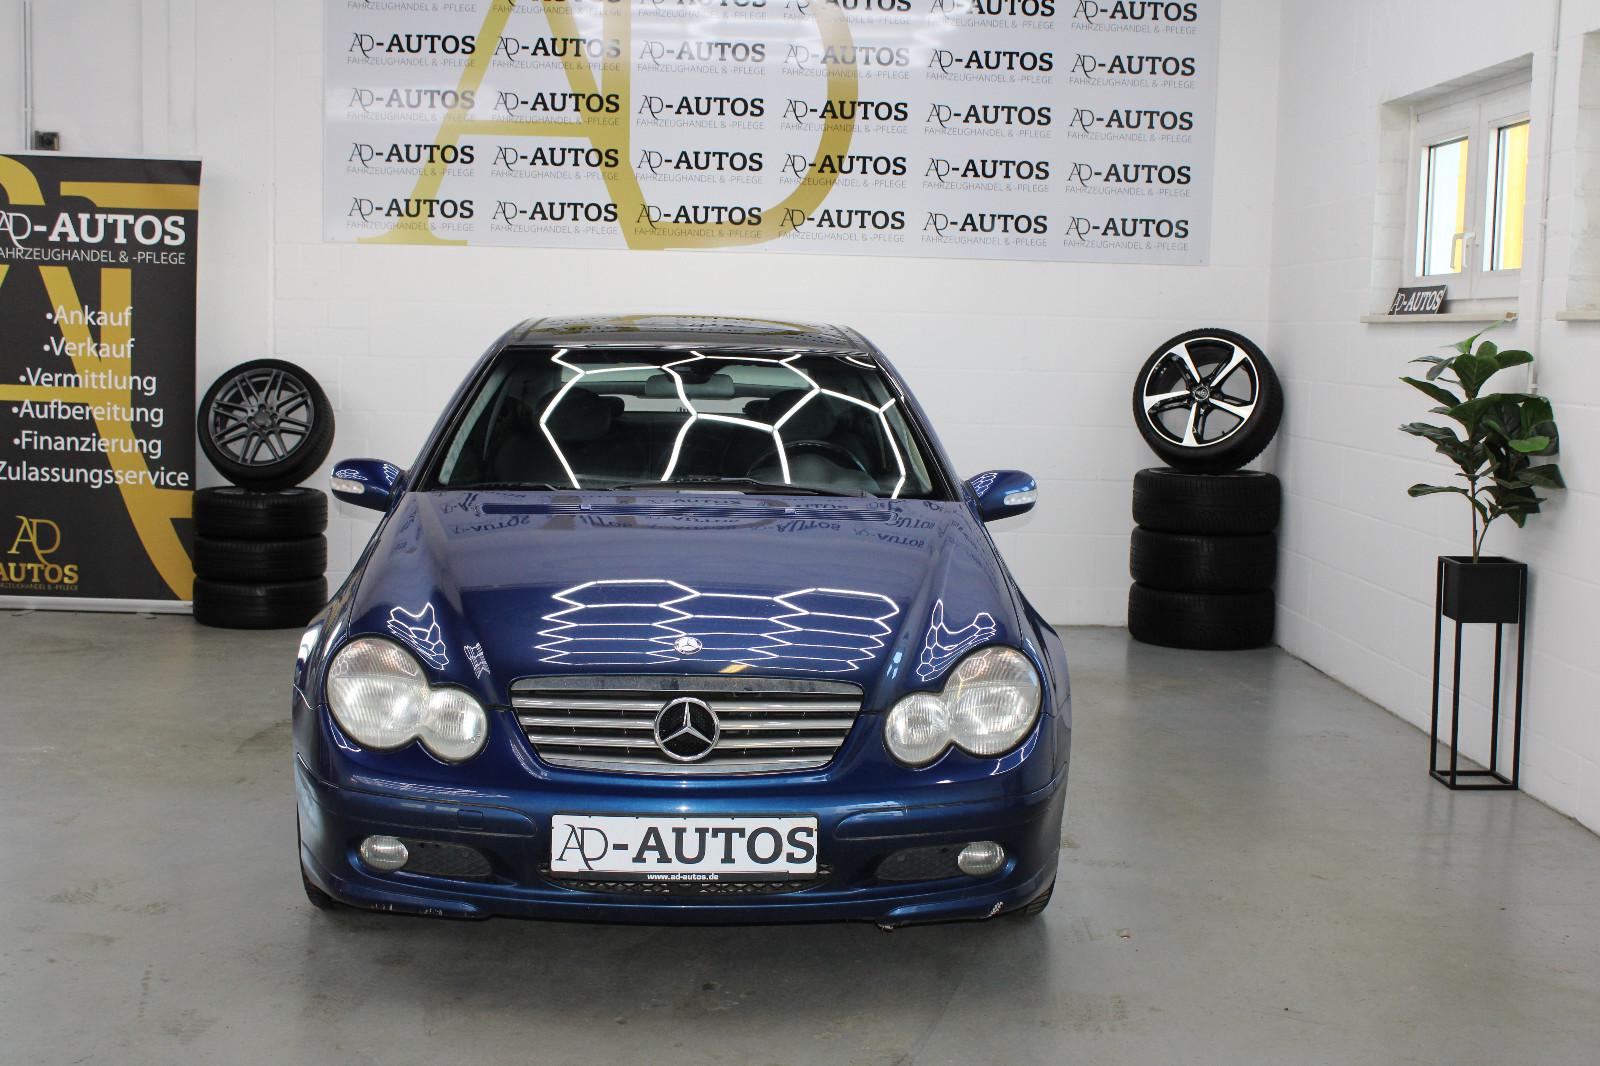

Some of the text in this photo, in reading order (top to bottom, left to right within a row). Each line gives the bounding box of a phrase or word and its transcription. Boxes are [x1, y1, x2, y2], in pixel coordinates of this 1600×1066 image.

[1073, 0, 1198, 25] AD-AUTOS
[348, 32, 476, 59] AD-AUTOS
[927, 48, 1053, 74] AD-AUTOS
[1071, 53, 1196, 79] AD-AUTOS
[493, 91, 620, 117] AD-AUTOS
[638, 94, 765, 120] AD-AUTOS
[782, 98, 908, 124] AD-AUTOS
[926, 103, 1051, 129] AD-AUTOS
[1069, 108, 1194, 133] AD-AUTOS
[347, 142, 475, 168] AD-AUTOS
[492, 145, 619, 171] AD-AUTOS
[637, 149, 763, 175] AD-AUTOS
[781, 153, 907, 179] AD-AUTOS
[924, 157, 1050, 183] AD-AUTOS
[1067, 162, 1192, 187] AD-AUTOS
[347, 197, 474, 223] AD-AUTOS
[492, 200, 618, 226] AD-AUTOS
[636, 204, 762, 229] AD-AUTOS
[779, 207, 905, 233] AD-AUTOS
[922, 212, 1048, 237] AD-AUTOS
[1065, 216, 1190, 241] AD-AUTOS
[0, 247, 186, 264] AHRZEUGHANDEL & -PFLEGE
[555, 823, 815, 871] AD-AUTOS
[647, 873, 719, 881] www.ad-autos.de
